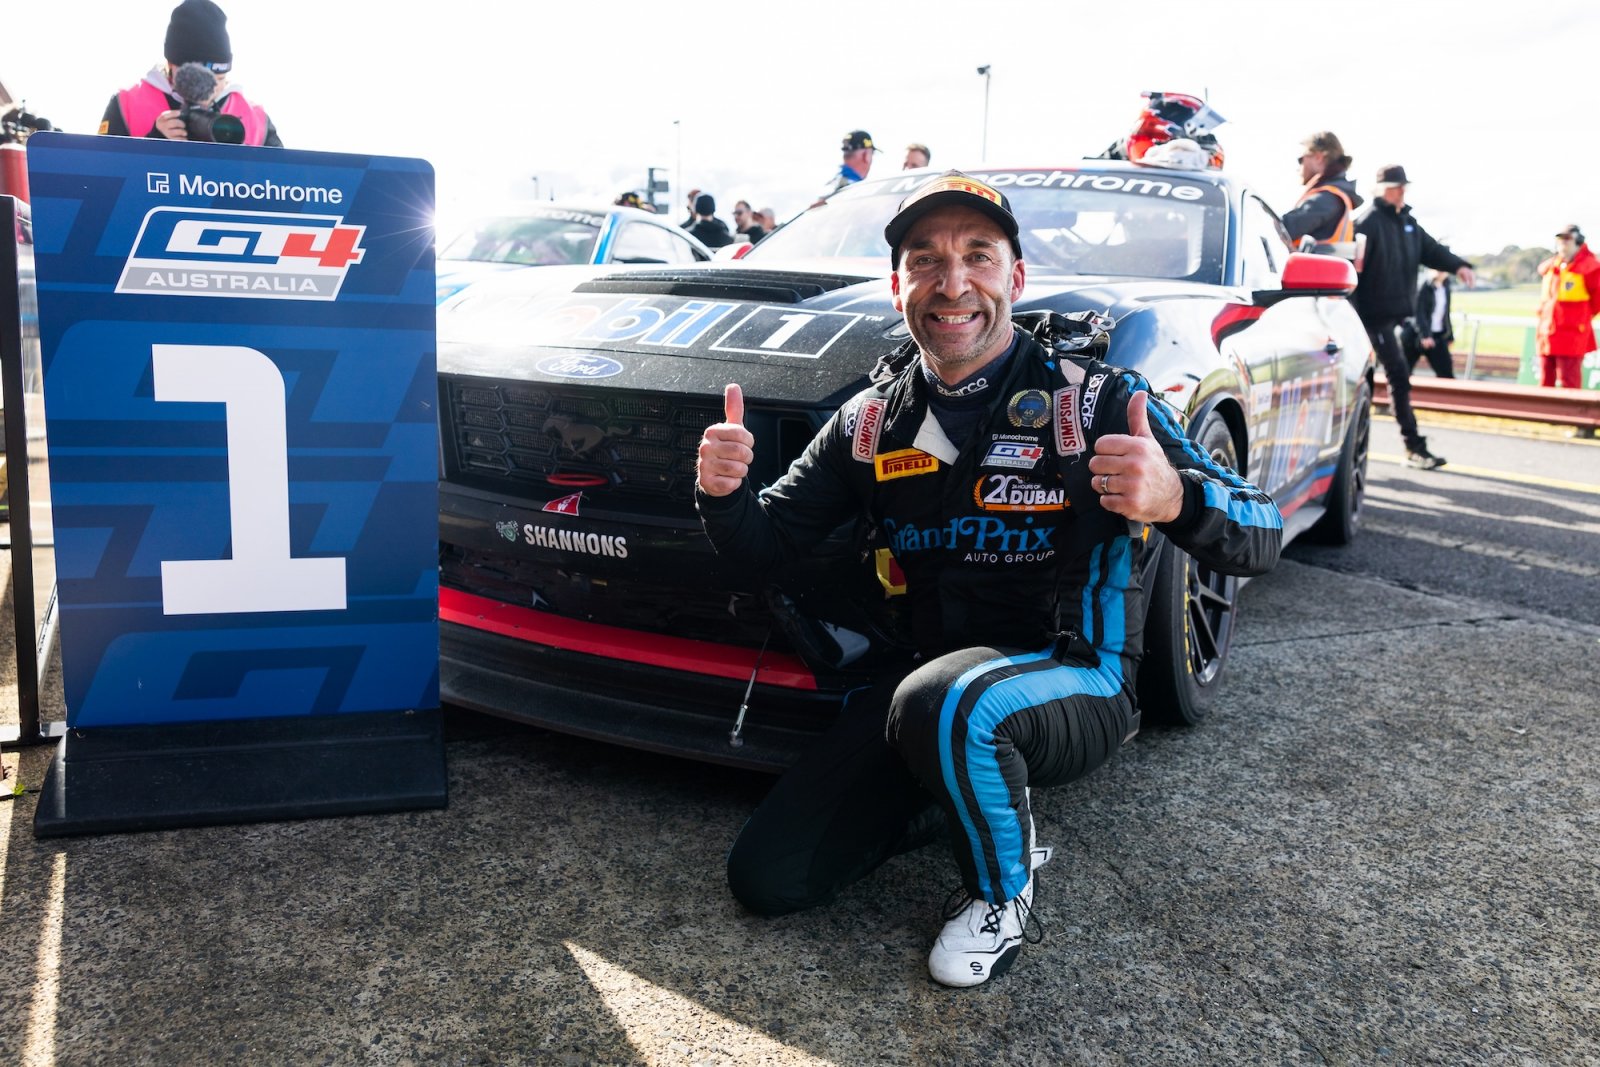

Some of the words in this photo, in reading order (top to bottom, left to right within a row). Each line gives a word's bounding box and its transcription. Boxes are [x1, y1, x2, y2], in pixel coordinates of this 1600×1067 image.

[179, 174, 343, 204] Monochrome
[891, 170, 1204, 200] Mochrome
[165, 218, 361, 268] GT4
[145, 271, 319, 292] AUSTRALIA
[548, 356, 608, 375] Ford
[858, 404, 880, 456] SIMPSON
[1060, 394, 1077, 447] SIMPSON
[999, 433, 1039, 442] Monochrome
[882, 452, 933, 475] PIRELLI
[987, 458, 1030, 467] AUSTRALIA
[992, 444, 1043, 460] GT4
[151, 343, 348, 616] 1
[1009, 489, 1065, 505] DUBAI
[523, 523, 628, 559] SHANNONS
[884, 517, 960, 557] Grand
[958, 516, 1056, 551] Prix
[964, 552, 998, 563] AUTO
[1004, 550, 1055, 563] GROUP
